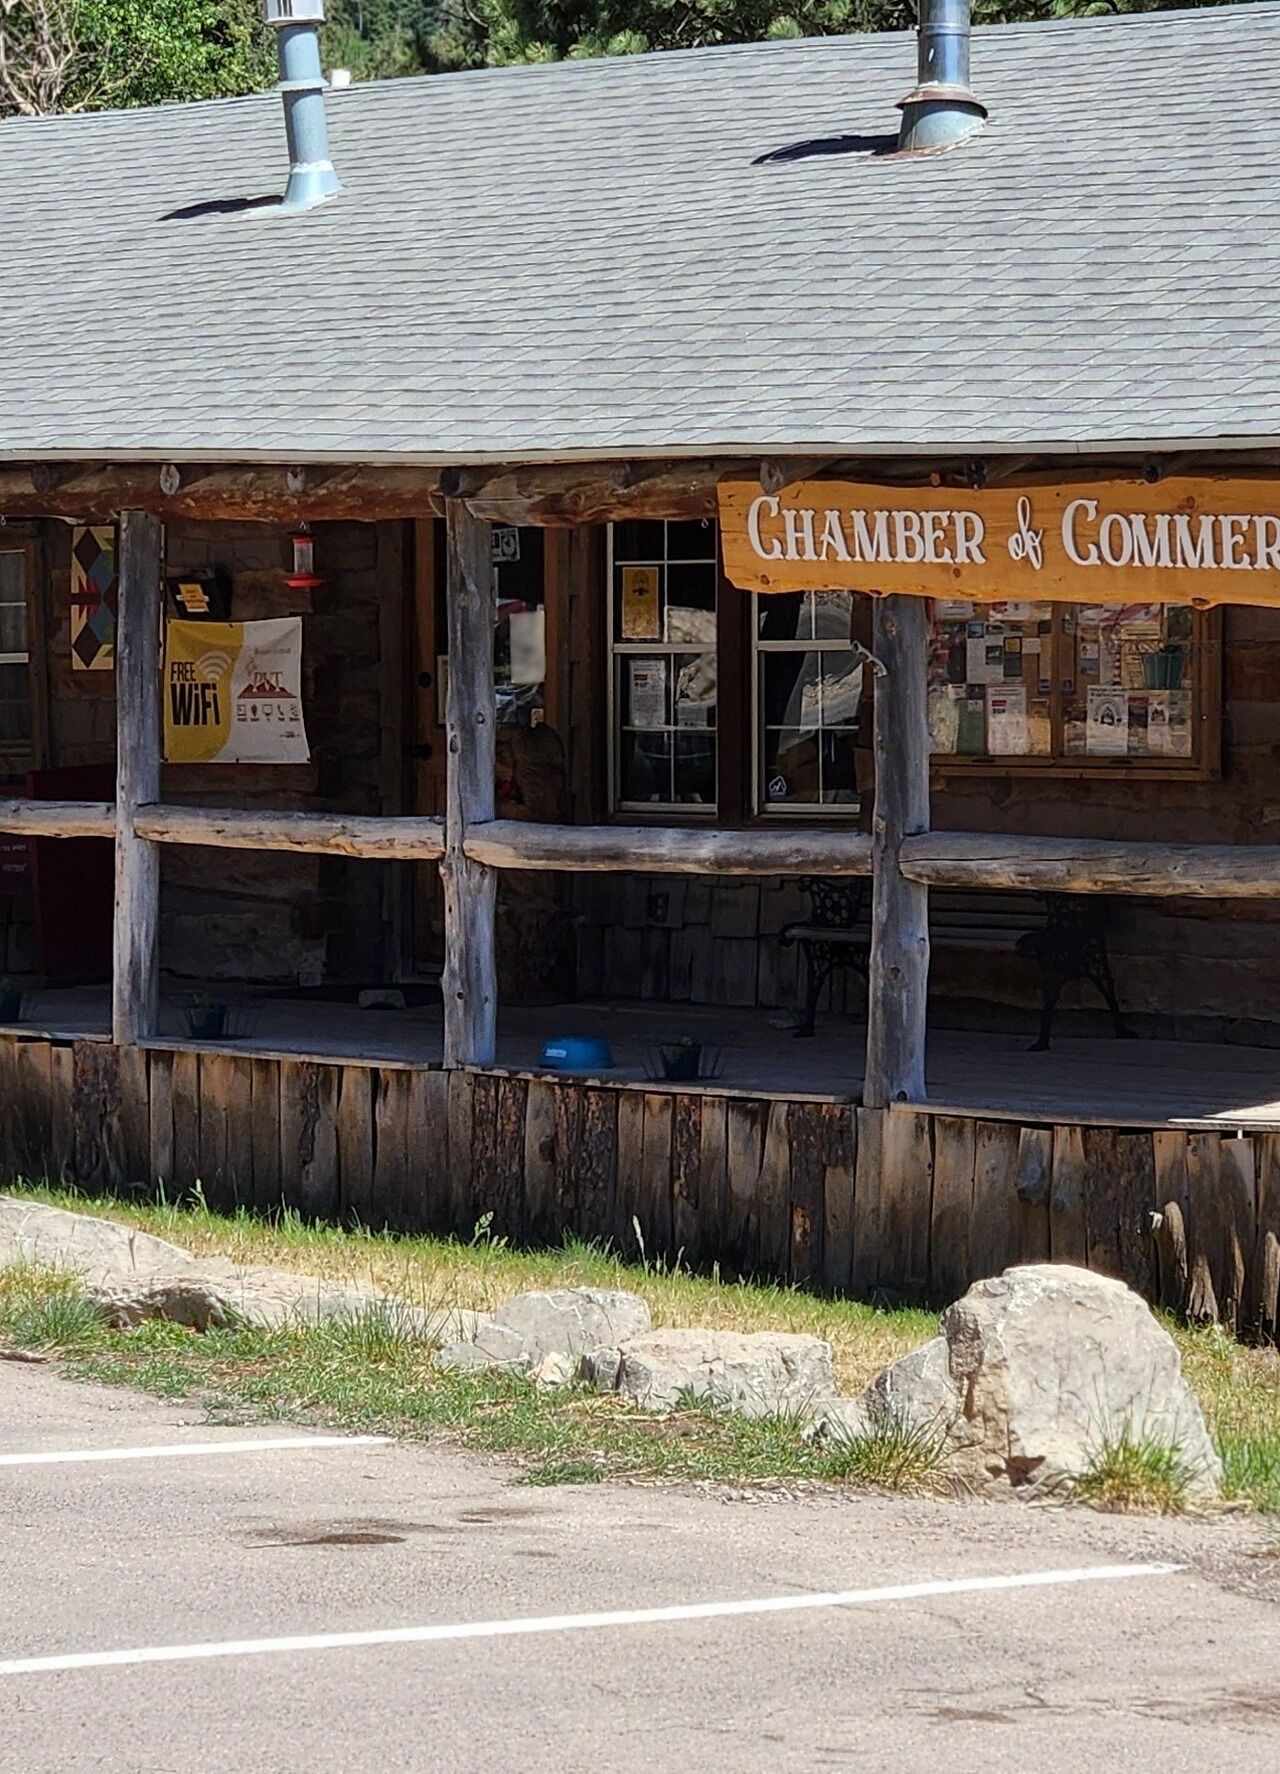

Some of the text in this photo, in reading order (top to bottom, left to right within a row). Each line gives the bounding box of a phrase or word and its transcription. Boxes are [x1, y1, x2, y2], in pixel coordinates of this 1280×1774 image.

[748, 495, 986, 565] CHAMBER
[1008, 495, 1042, 571] of
[171, 662, 196, 682] FREE
[170, 683, 220, 726] WiFi
